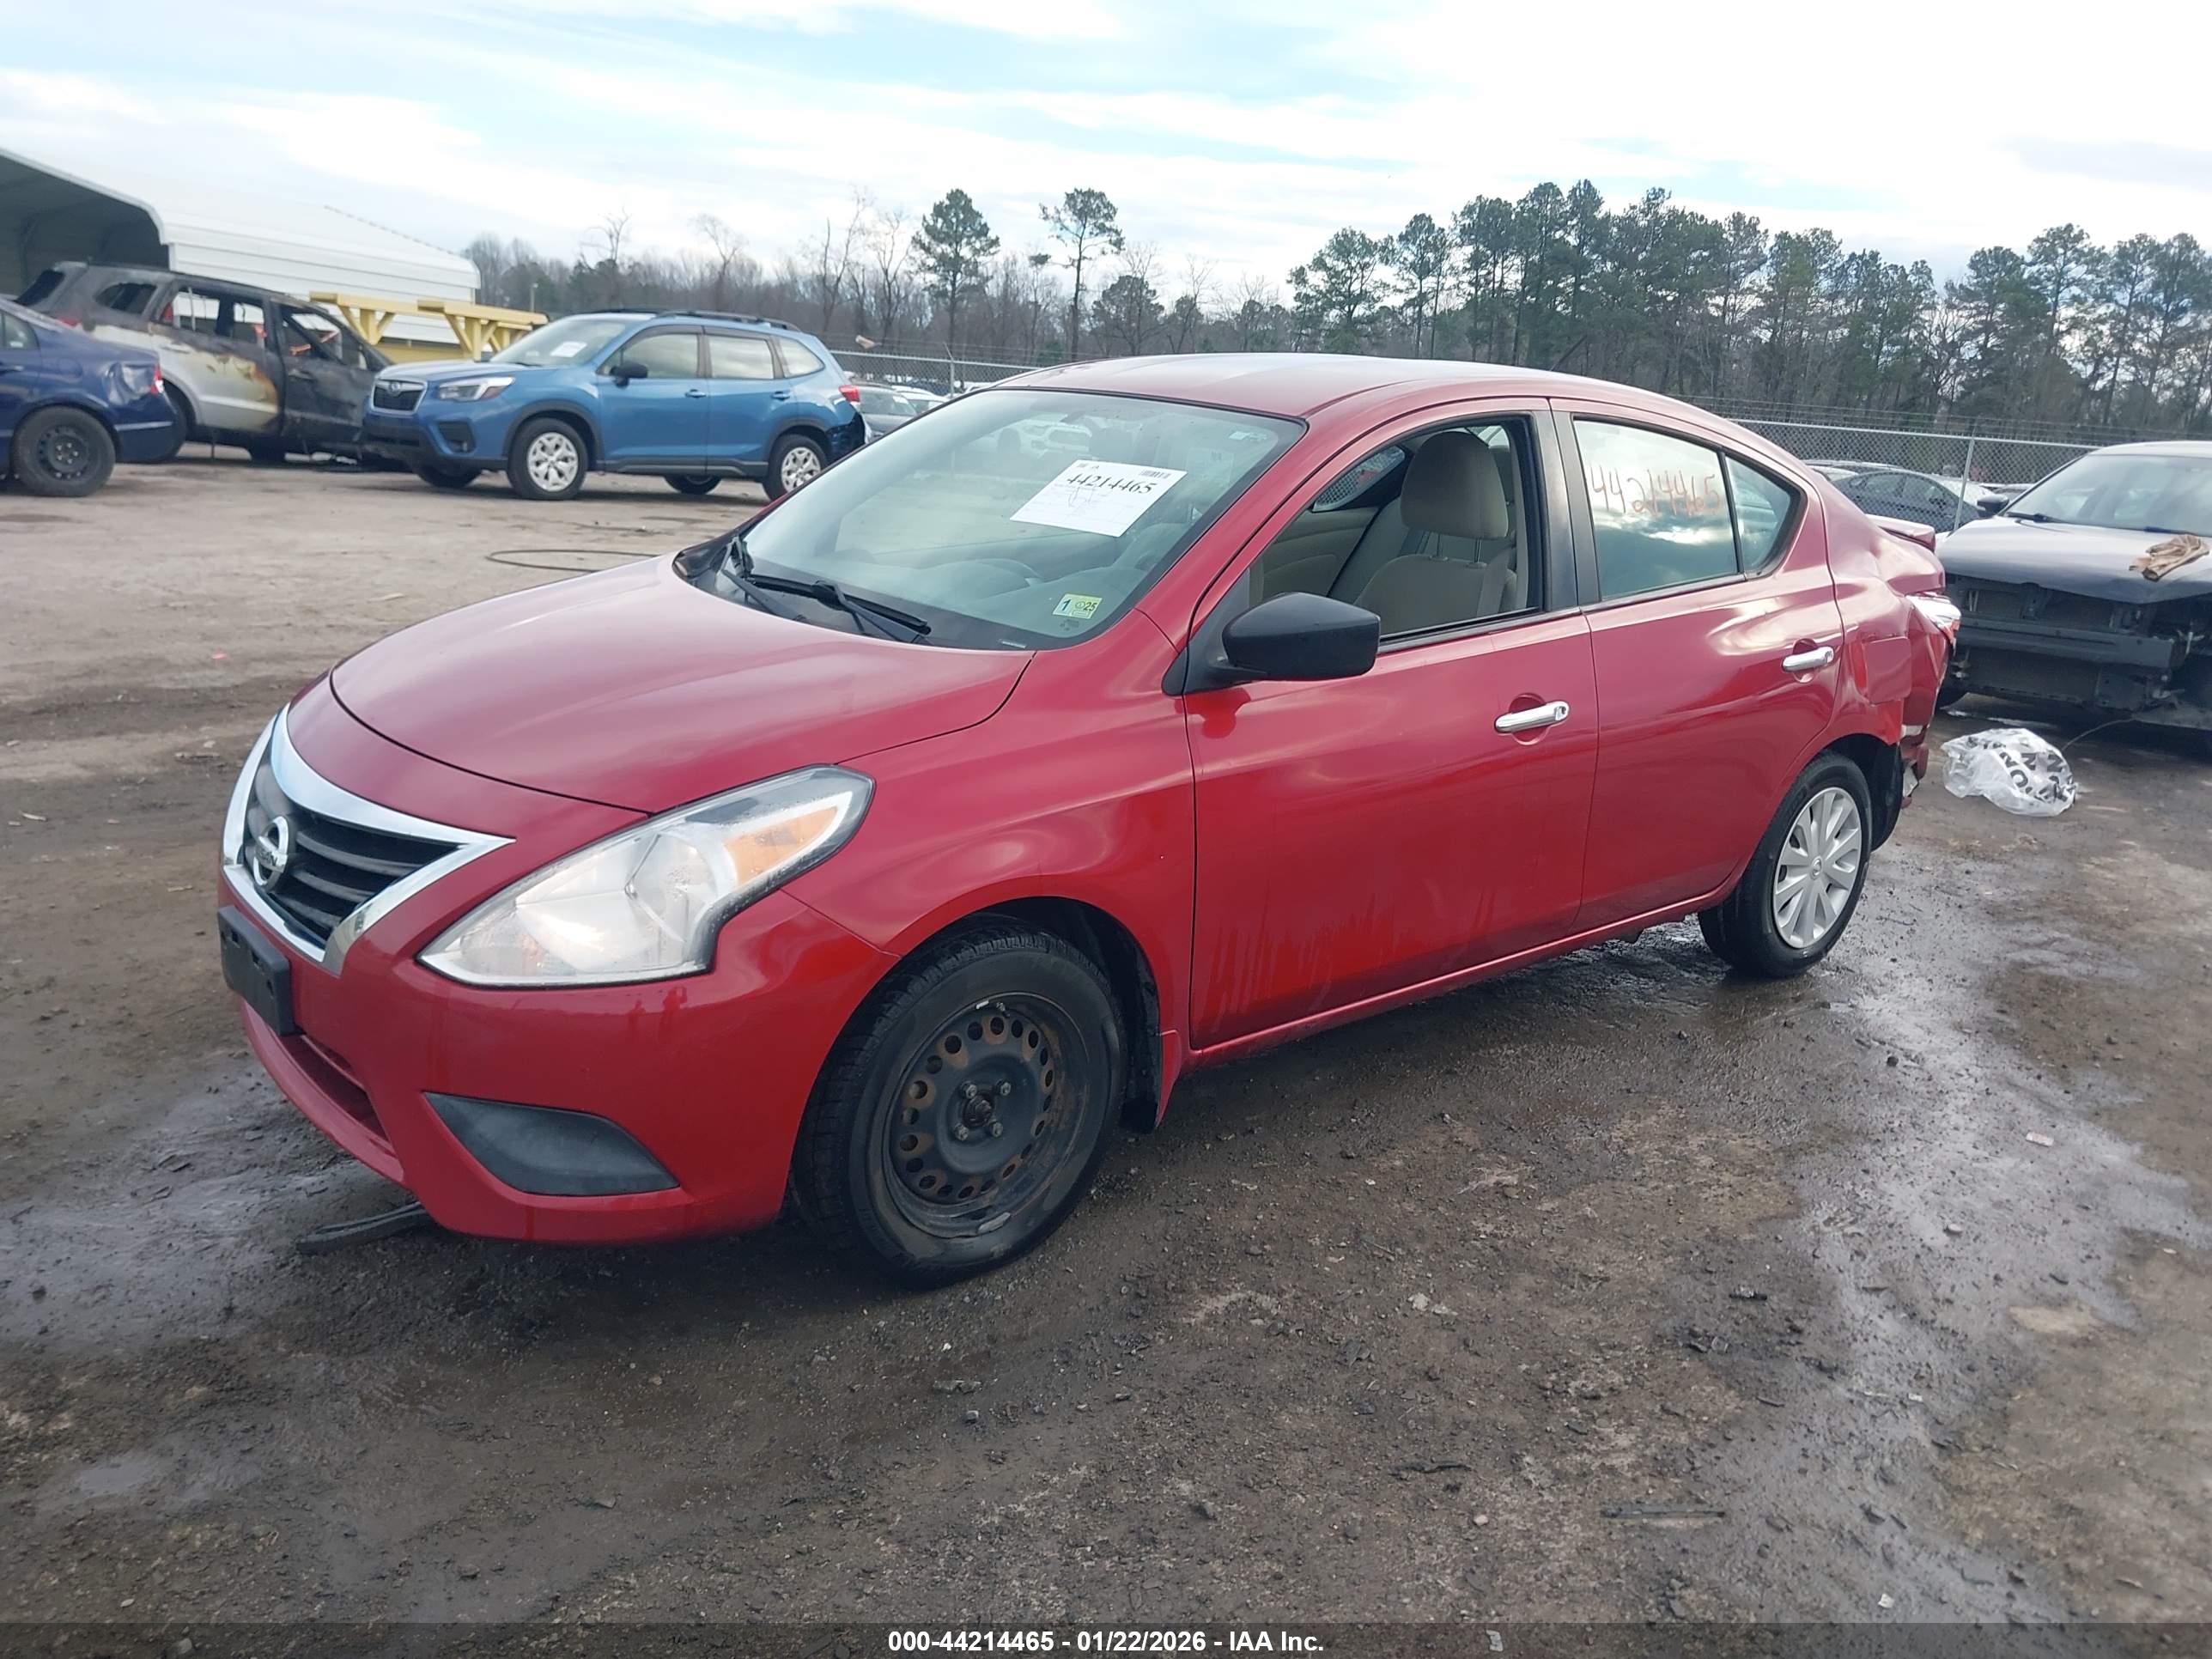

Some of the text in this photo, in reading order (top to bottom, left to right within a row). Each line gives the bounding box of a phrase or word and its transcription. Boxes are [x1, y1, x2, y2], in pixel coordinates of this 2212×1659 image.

[1066, 472, 1158, 495] 44214465
[1589, 465, 1721, 517] 44214465
[1061, 599, 1097, 612] 1 25
